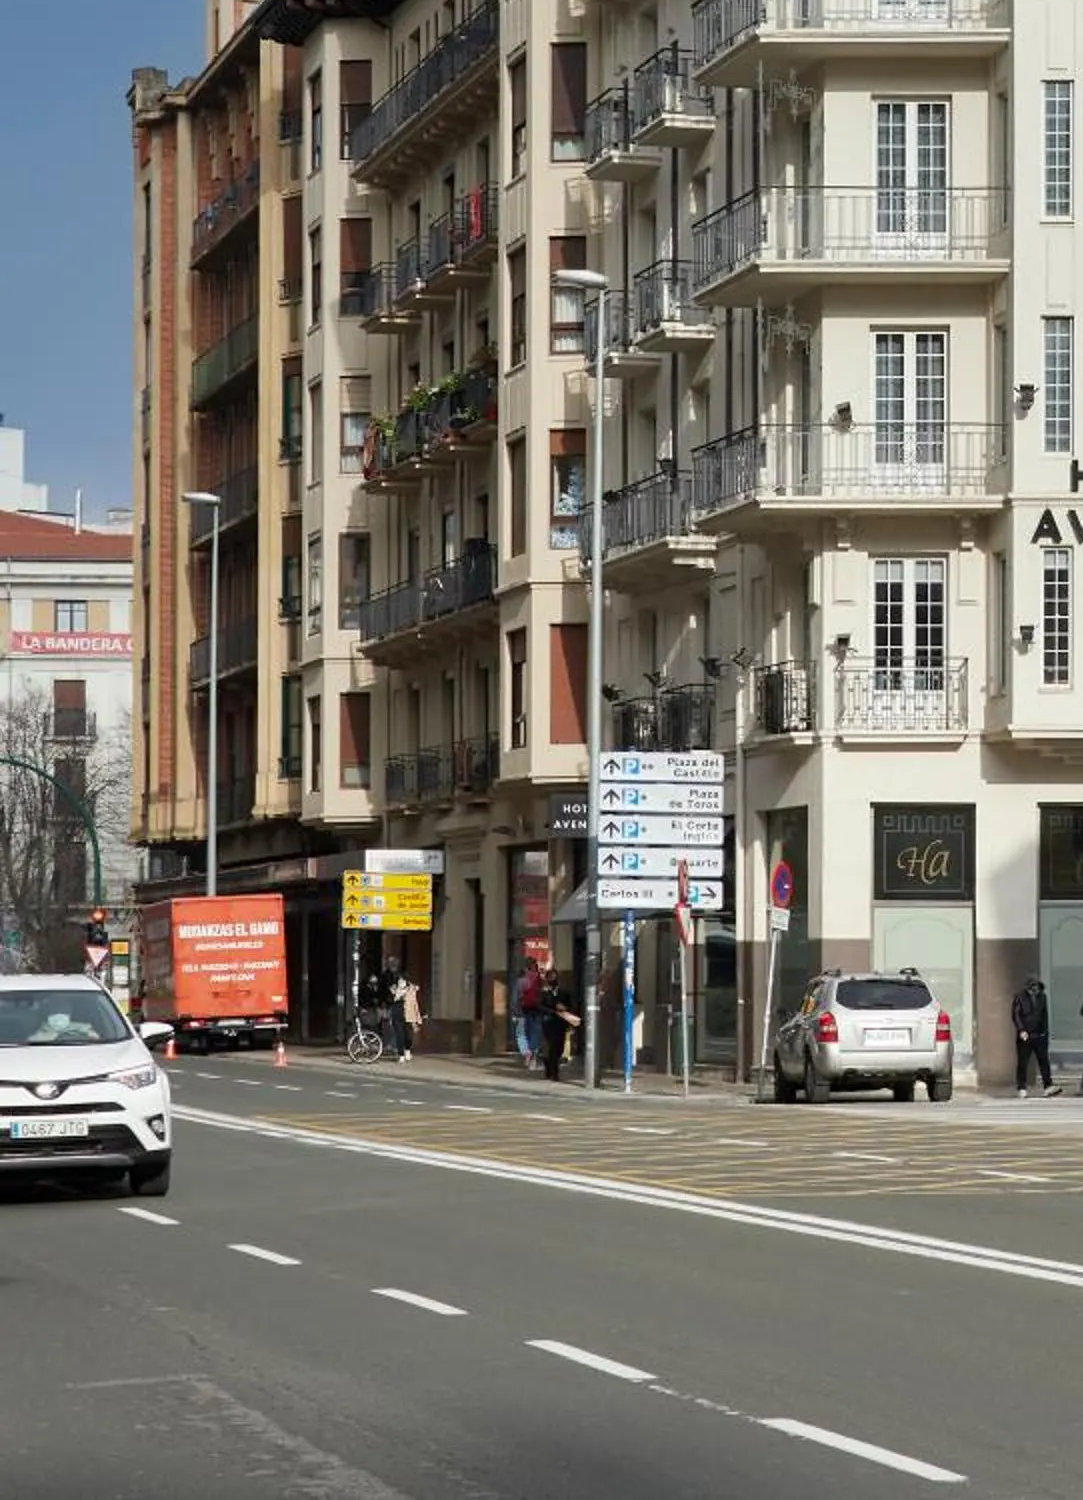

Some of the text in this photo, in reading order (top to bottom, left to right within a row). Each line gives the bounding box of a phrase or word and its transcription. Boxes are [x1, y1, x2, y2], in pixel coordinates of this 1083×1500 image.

[21, 636, 40, 649] LA
[667, 757, 719, 767] Plaza del
[689, 789, 719, 798] Plaza
[563, 803, 587, 814] HOT
[687, 800, 719, 809] Toros
[553, 819, 587, 829] AVEN
[687, 821, 719, 830] Corte
[896, 839, 950, 885] Ha
[601, 889, 639, 899] Carlos
[179, 924, 234, 939] MUDANZAS
[235, 923, 249, 937] EL
